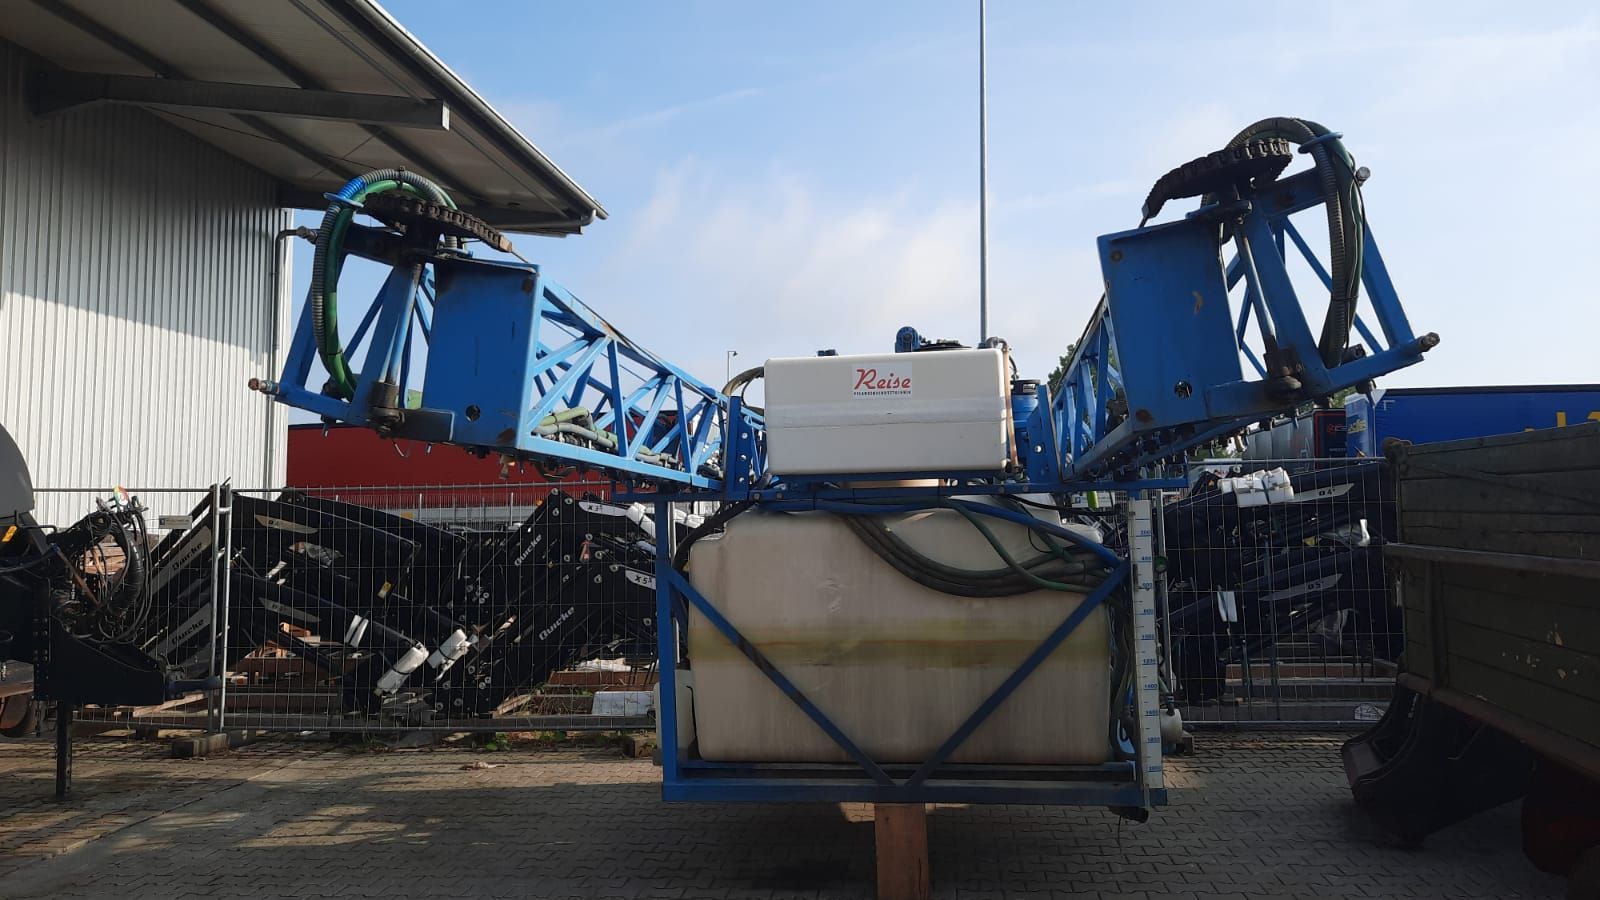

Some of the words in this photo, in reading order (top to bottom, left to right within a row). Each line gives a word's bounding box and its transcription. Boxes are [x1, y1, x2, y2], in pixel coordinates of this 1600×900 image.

[854, 368, 911, 390] Reise
[514, 533, 542, 566] Quicke
[538, 606, 575, 641] Quicke
